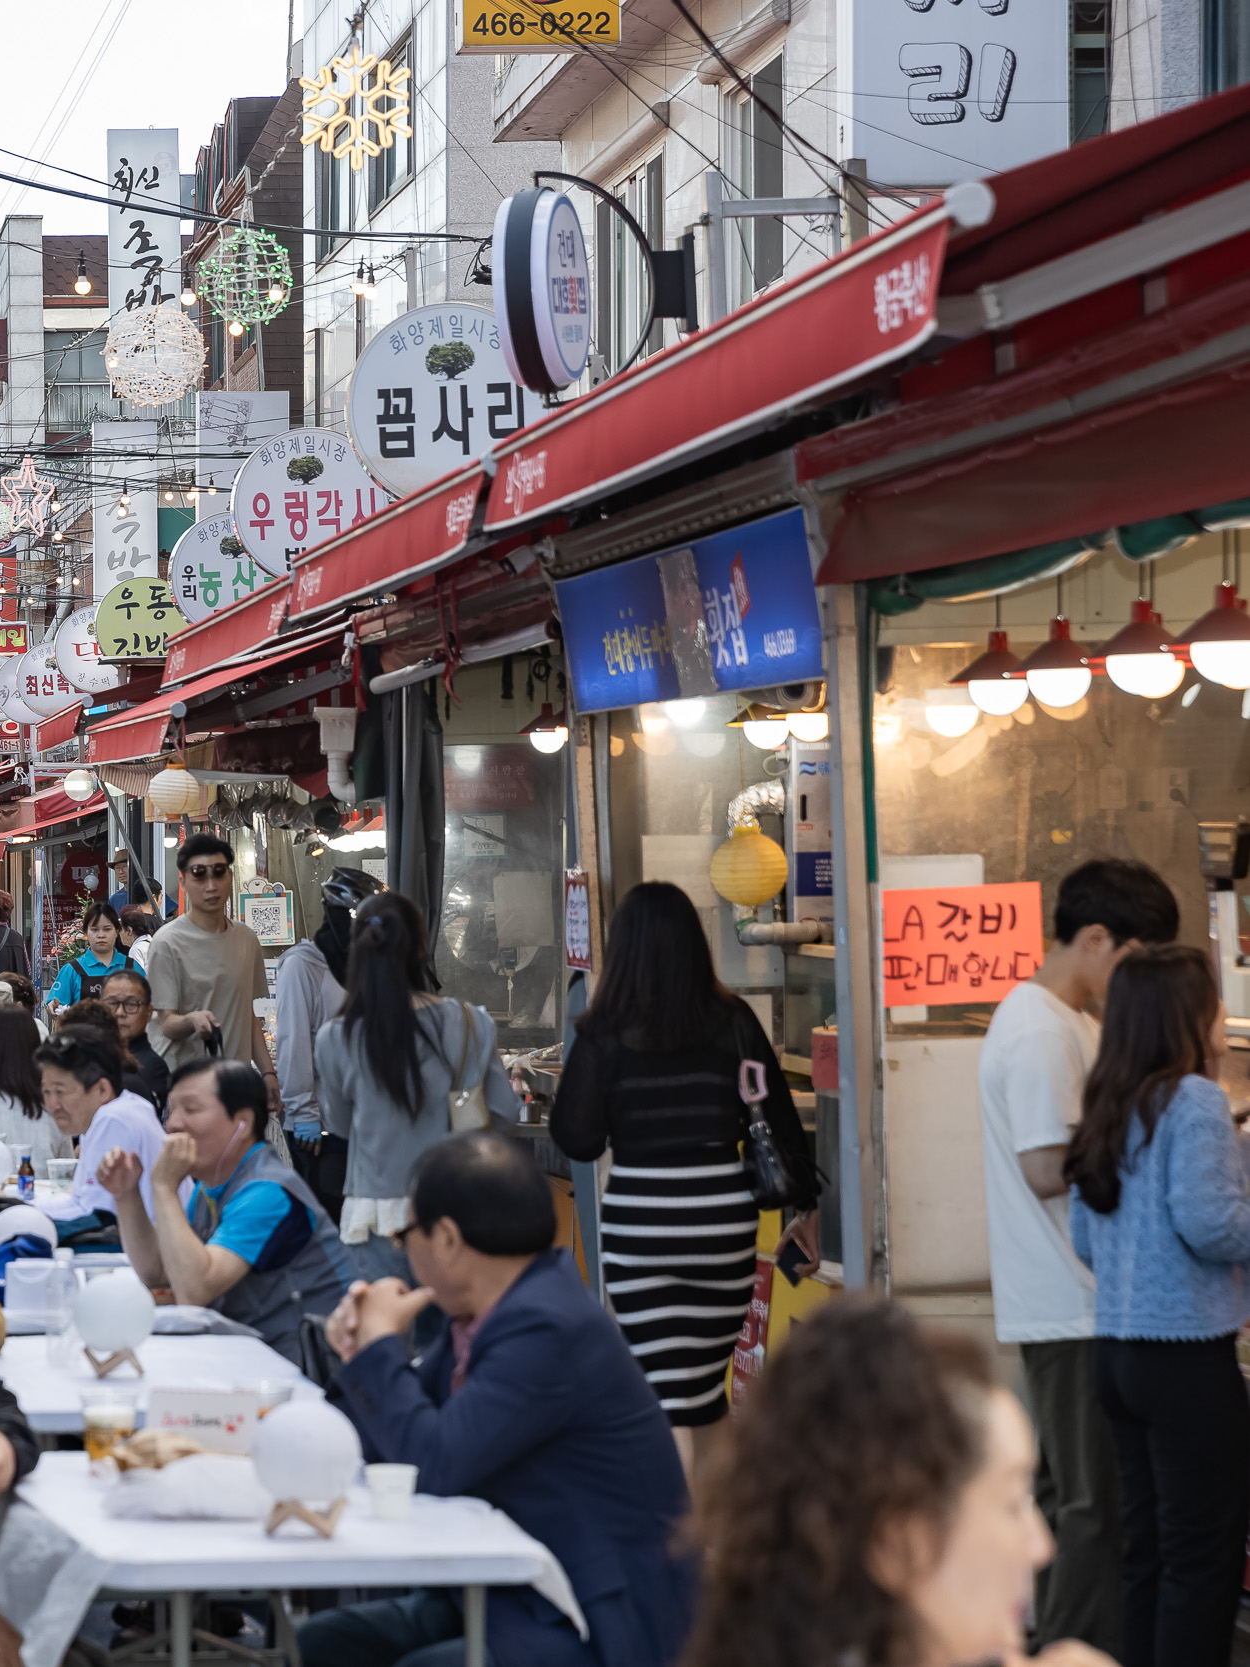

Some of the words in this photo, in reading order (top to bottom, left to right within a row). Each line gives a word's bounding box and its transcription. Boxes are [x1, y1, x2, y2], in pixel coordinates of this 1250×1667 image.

[472, 11, 611, 36] 466-0222
[376, 382, 525, 459] 꼽사리
[259, 436, 347, 466] 화양제일시장
[250, 487, 376, 541] 우렁각시
[181, 565, 197, 601] 우리
[199, 561, 276, 607] 농산
[115, 586, 175, 620] 우동
[26, 674, 84, 697] 최신족
[937, 900, 1017, 942] 갈비
[884, 951, 1041, 991] 판매합니다
